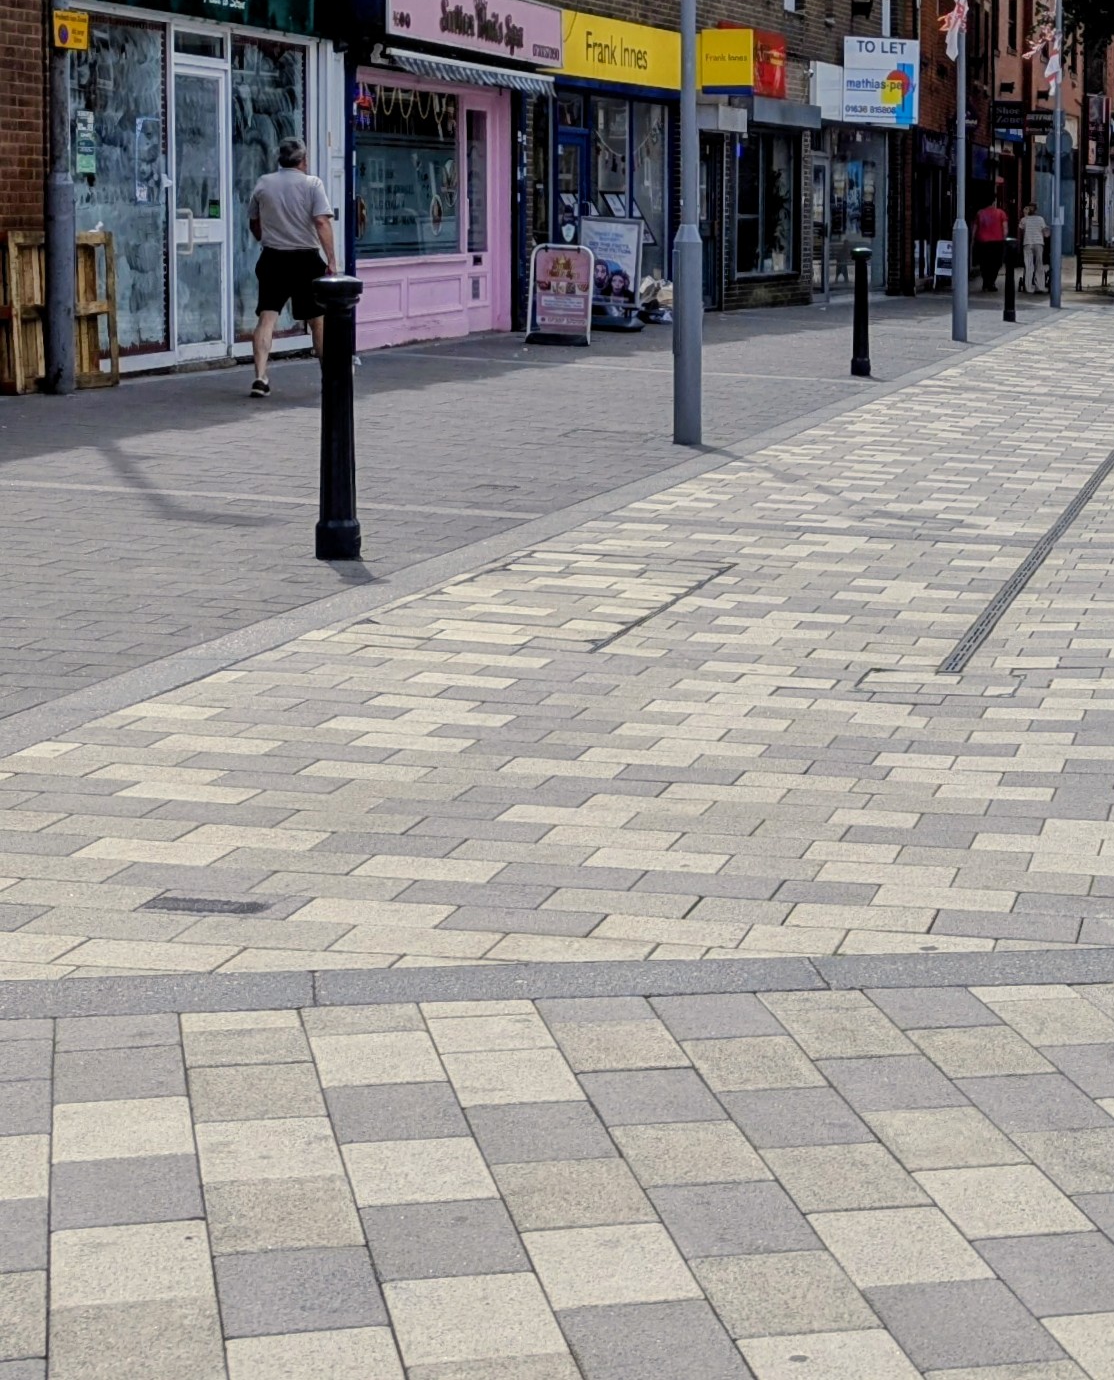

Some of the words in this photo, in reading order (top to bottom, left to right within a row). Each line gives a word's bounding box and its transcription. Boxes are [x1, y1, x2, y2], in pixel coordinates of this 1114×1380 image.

[504, 14, 524, 56] Spa
[586, 31, 617, 66] Frank
[620, 38, 648, 70] Innes
[857, 40, 876, 53] TO
[881, 42, 906, 55] LET
[705, 53, 726, 62] Frank
[728, 54, 748, 62] Innes
[996, 106, 1019, 115] Shoe
[996, 116, 1022, 124] Zone
